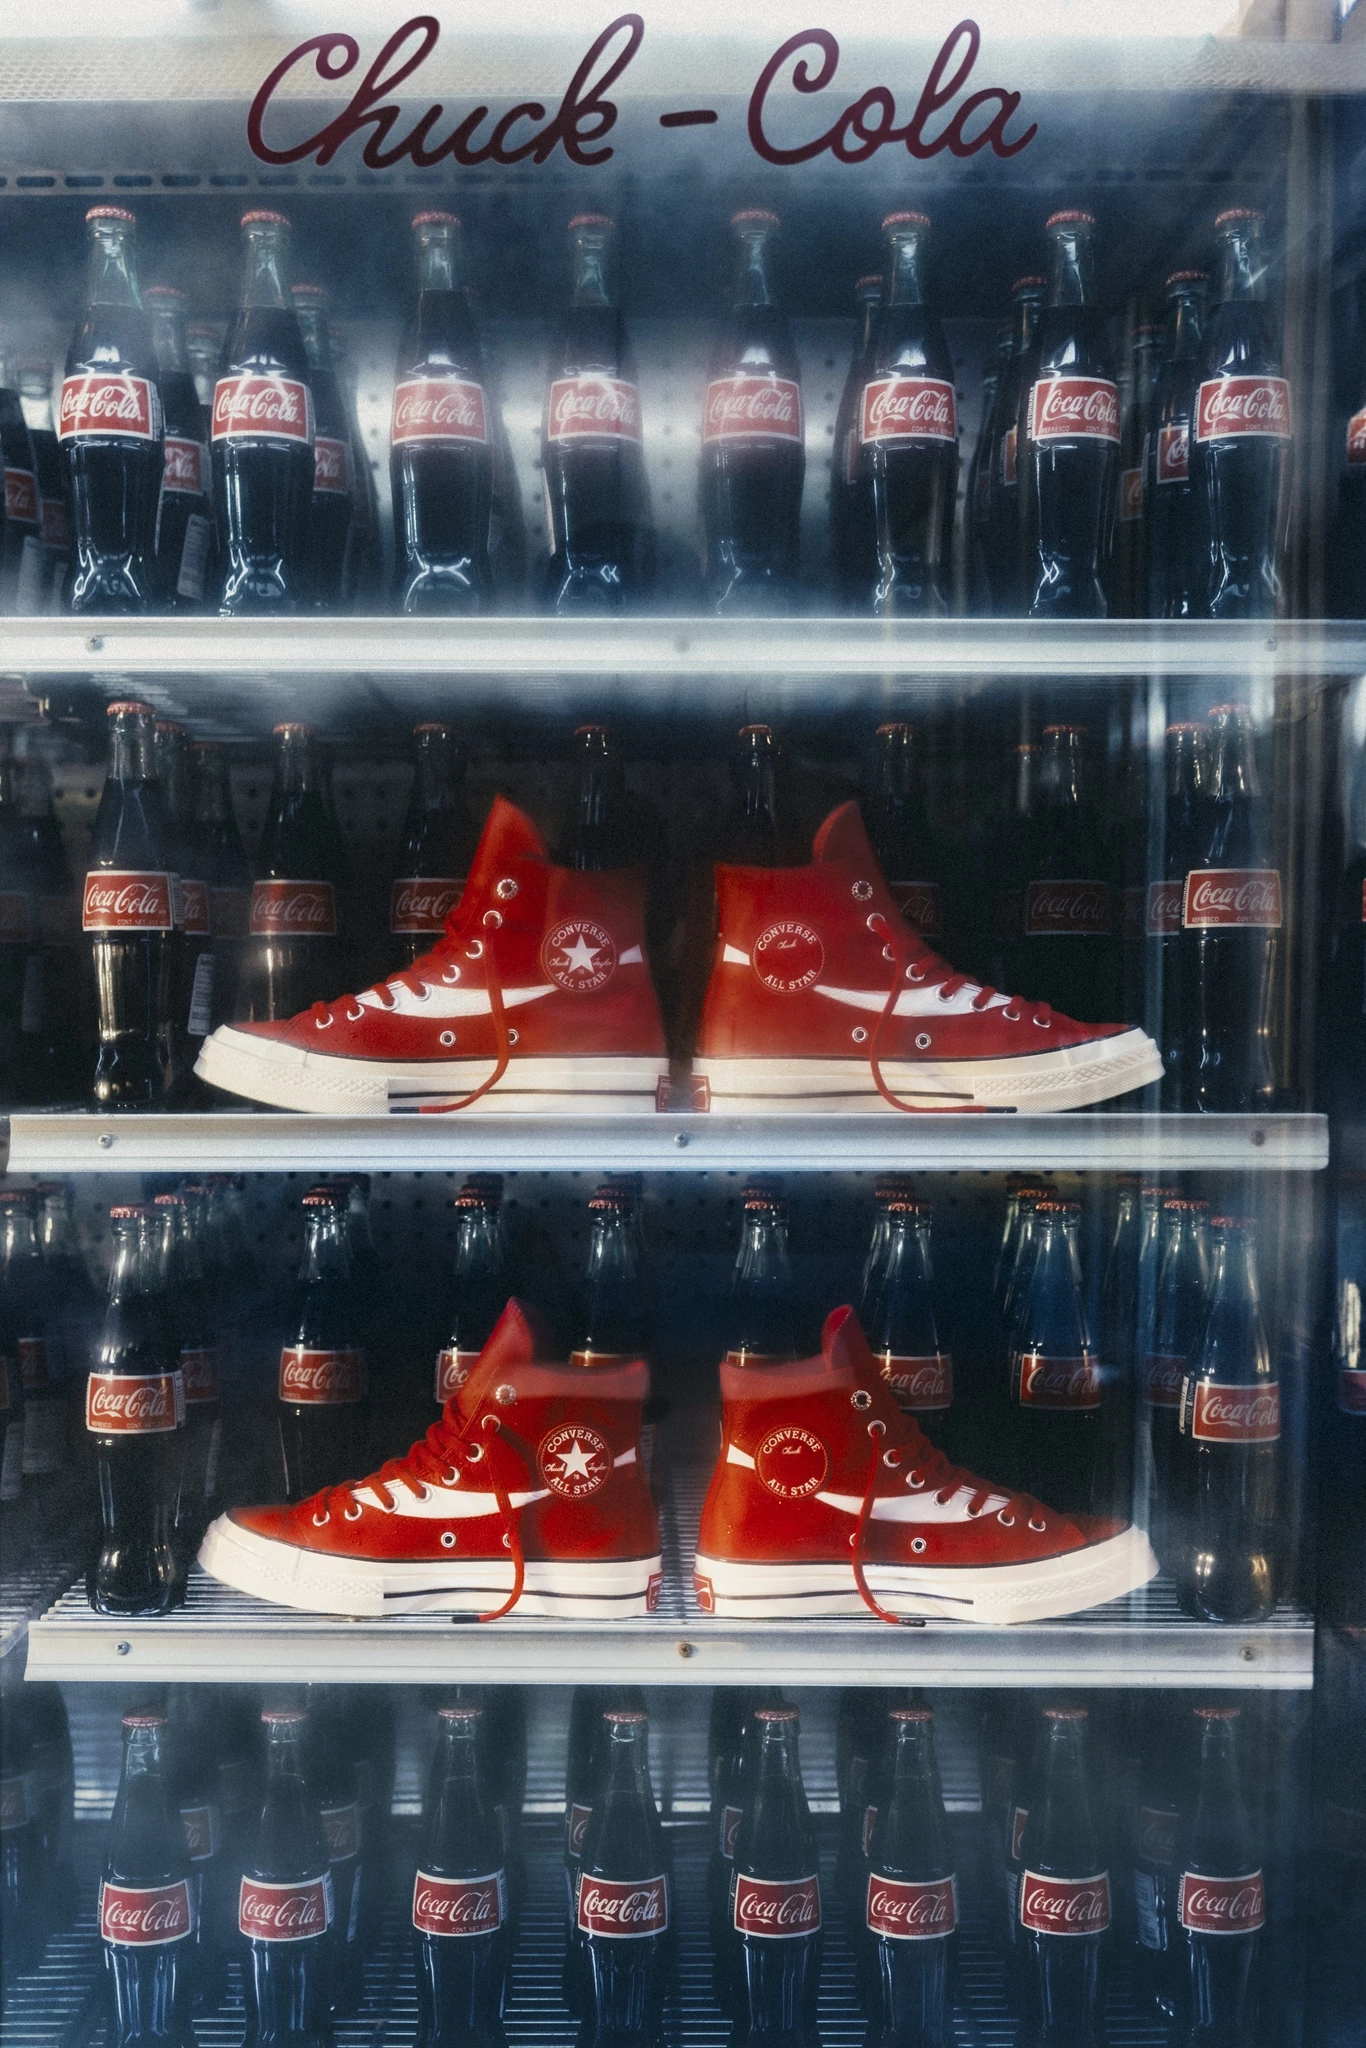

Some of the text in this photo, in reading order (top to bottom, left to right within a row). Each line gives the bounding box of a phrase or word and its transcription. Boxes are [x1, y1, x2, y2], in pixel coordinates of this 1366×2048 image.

[247, 14, 644, 168] Chuck
[747, 19, 1039, 166] Cola
[61, 386, 141, 421] Coca-Cola
[216, 387, 299, 422] Coca-Cola
[396, 393, 477, 428] Coca-Cola
[555, 388, 636, 424] Coca-Cola
[710, 388, 793, 423] Coca-Cola
[869, 389, 949, 424] Coca-Cola
[1042, 389, 1118, 425] Coca-Cola
[1203, 388, 1284, 423] Coca-Cola
[85, 883, 160, 915] Coca-Cola
[1192, 880, 1275, 912] Coca-Cola
[551, 923, 610, 947] CONVERSE
[757, 923, 817, 951] CONVERSE
[777, 939, 798, 950] Chuck
[549, 957, 570, 967] Chuck
[555, 971, 607, 989] ALL STAR
[764, 969, 817, 990] ALL STAR
[91, 1386, 167, 1418] Coca-Cola
[1201, 1395, 1279, 1428] Coca-Cola
[547, 1429, 605, 1453] CONVERSE
[763, 1430, 820, 1454] CONVERSE
[782, 1445, 802, 1455] Chuck
[545, 1462, 566, 1472] Chuck
[550, 1476, 602, 1494] ALL STAR
[767, 1477, 819, 1496] ALL STAR
[104, 1899, 182, 1932] Coca-Cola
[242, 1893, 318, 1928] Coca-Cola
[416, 1889, 492, 1923] Coca-Cola
[583, 1888, 660, 1923] Coca-Cola
[740, 1892, 815, 1926] Coca-Cola
[871, 1890, 948, 1925] Coca-Cola
[1026, 1888, 1103, 1922] Coca-Cola
[1187, 1887, 1263, 1918] Coca-Cola
